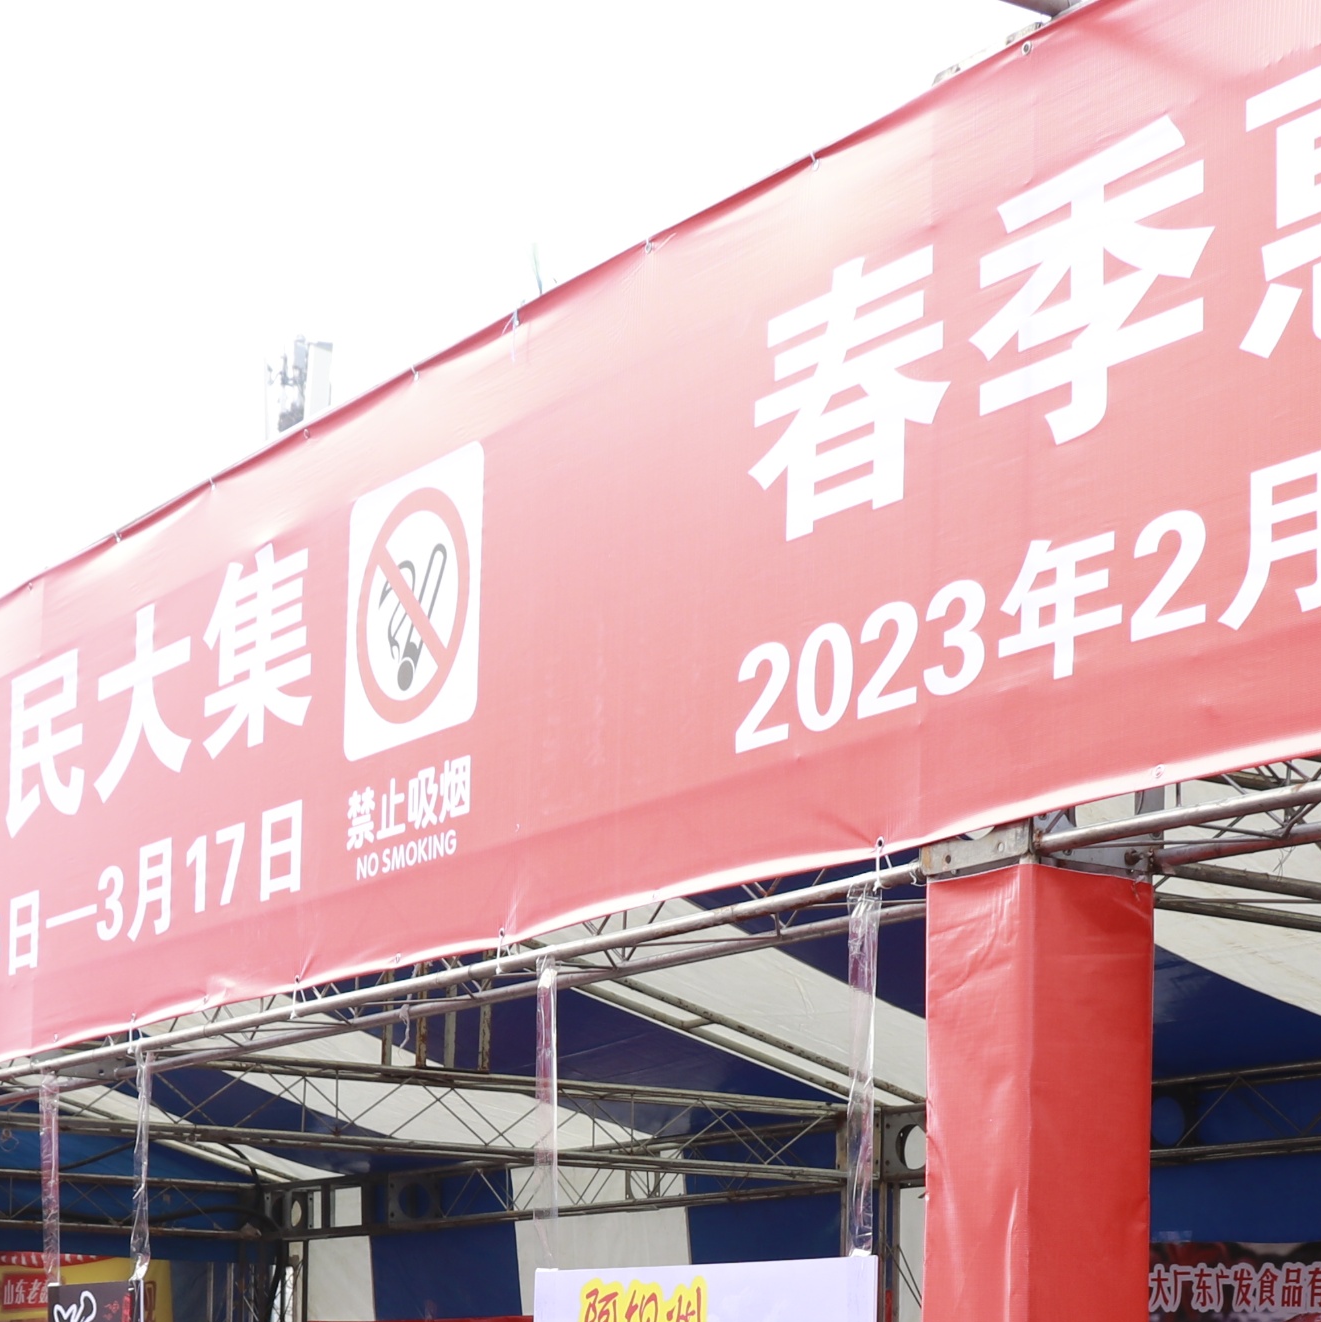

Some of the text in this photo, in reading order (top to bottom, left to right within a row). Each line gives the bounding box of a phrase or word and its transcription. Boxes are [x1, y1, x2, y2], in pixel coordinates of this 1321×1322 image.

[346, 755, 472, 851] 禁止吸烟
[355, 829, 458, 881] NO SMOKING
